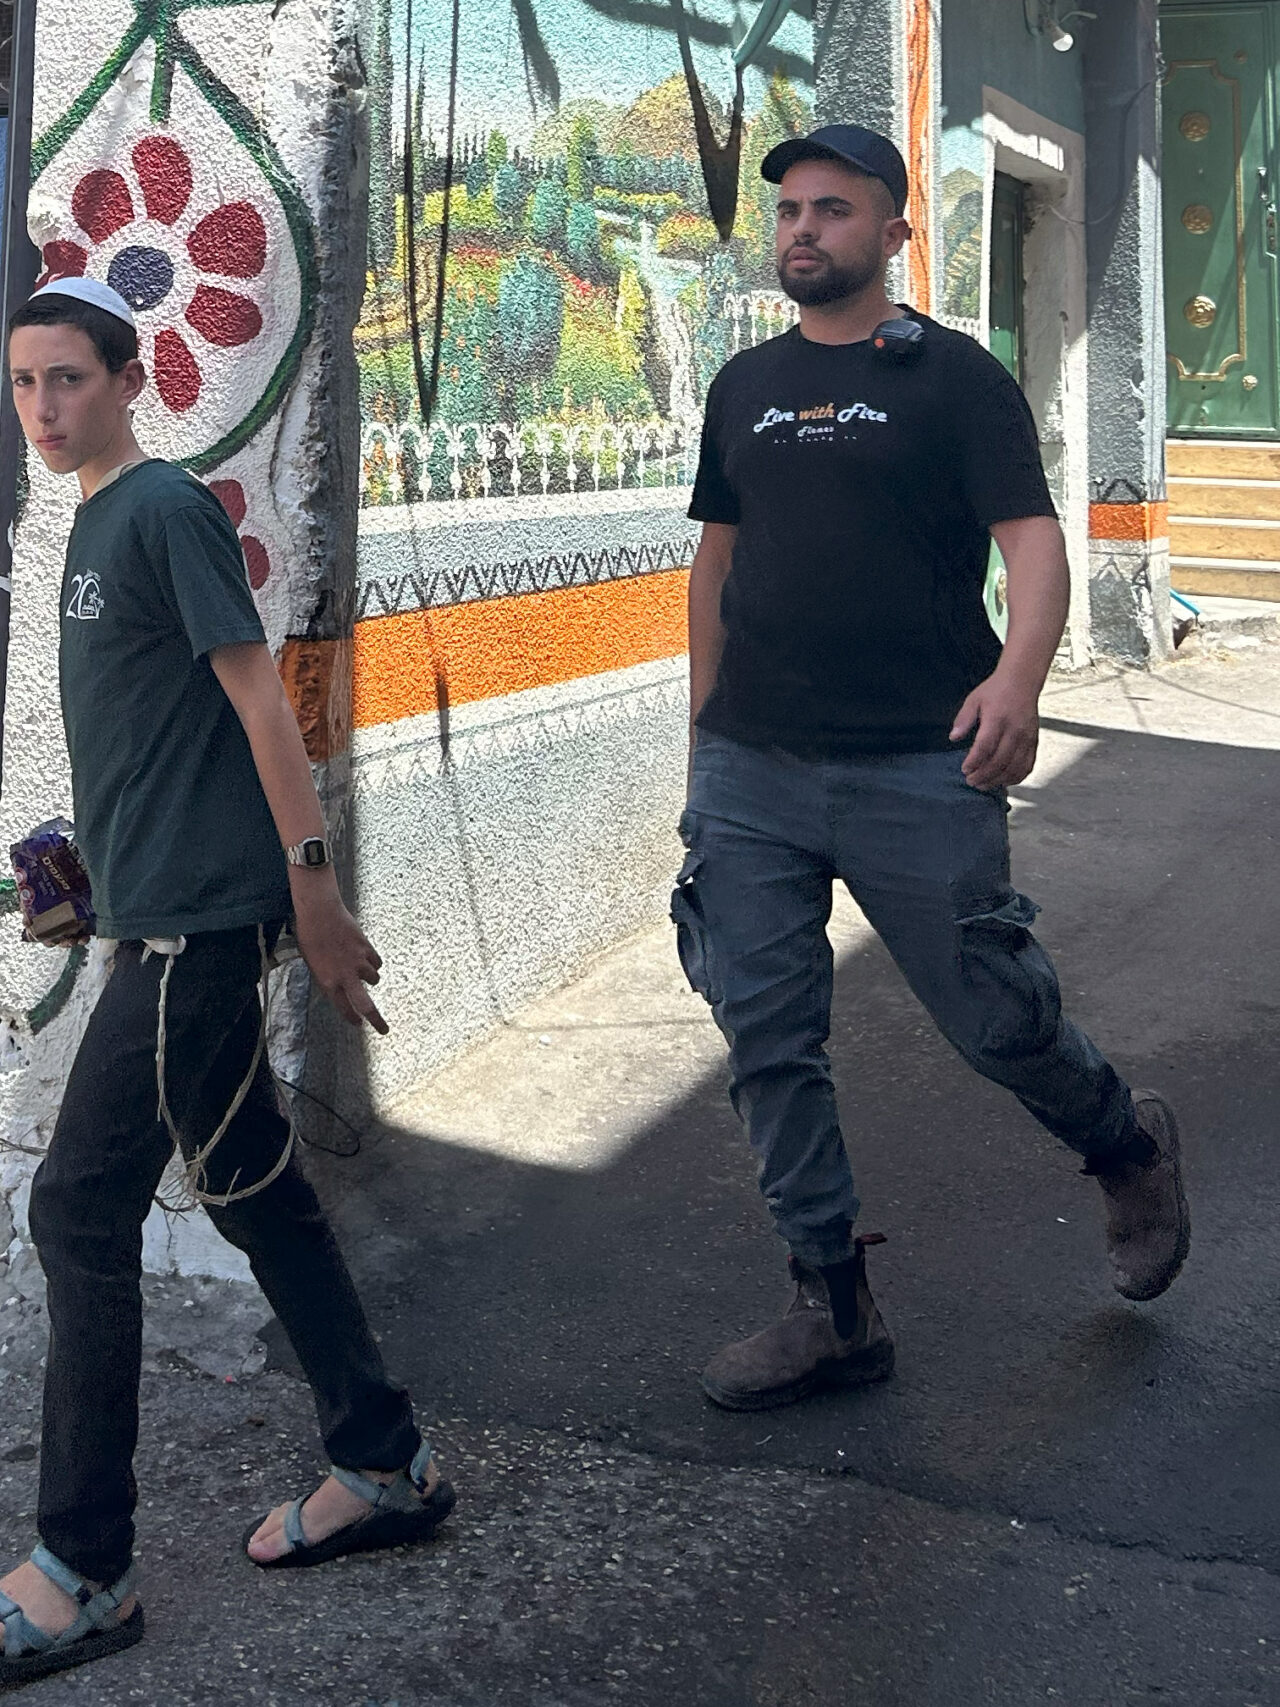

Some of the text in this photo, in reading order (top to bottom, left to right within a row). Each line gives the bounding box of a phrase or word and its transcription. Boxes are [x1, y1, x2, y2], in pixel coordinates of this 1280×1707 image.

[753, 402, 888, 433] Live with Fire
